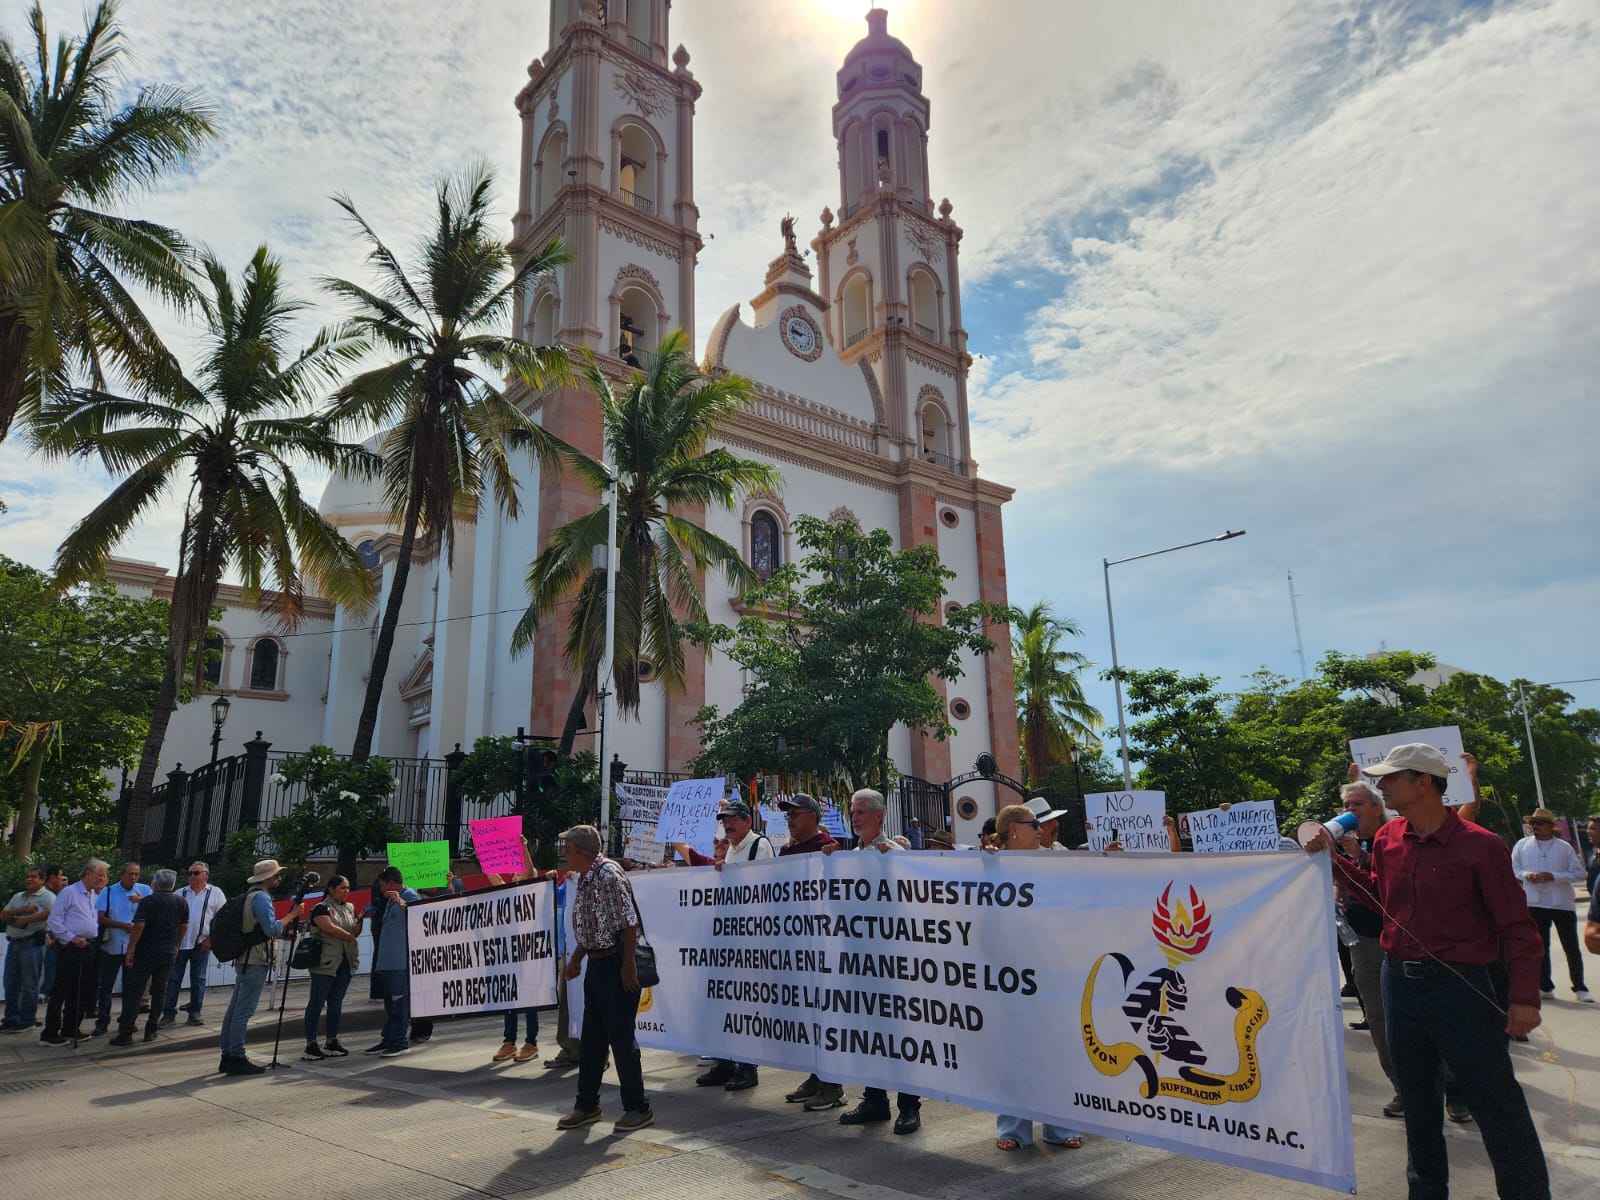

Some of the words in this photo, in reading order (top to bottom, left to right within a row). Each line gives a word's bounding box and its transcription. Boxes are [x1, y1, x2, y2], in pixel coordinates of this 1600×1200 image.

[674, 784, 712, 801] FUERA
[1106, 793, 1134, 814] NO
[665, 826, 698, 841] UAS
[1095, 814, 1153, 832] FOBAPROA
[1193, 813, 1218, 832] ALTO
[1228, 808, 1275, 825] AUMENTO
[1196, 834, 1203, 845] A
[1205, 831, 1224, 843] LAS
[1226, 824, 1276, 837] CUOTAS
[691, 881, 790, 907] DEMANDAMOS
[793, 878, 871, 902] RESPETO
[877, 879, 892, 902] A
[897, 879, 1035, 908] NUESTROS
[422, 909, 439, 937] SIN
[440, 900, 493, 935] AUDITORIA
[496, 897, 511, 926] NO
[513, 893, 536, 922] HAY
[712, 915, 781, 937] DERECHOS
[783, 914, 952, 945] CONTRACTUALES
[956, 920, 972, 946] Y
[410, 941, 473, 976] REINGENIERIA
[473, 940, 480, 967] Y
[482, 936, 509, 966] ESTA
[510, 929, 553, 963] EMPIEZA
[678, 947, 793, 972] TRANSPARENCIA
[795, 949, 816, 972] EN
[838, 951, 939, 984] MANEJO
[943, 961, 978, 990] DE
[983, 964, 1038, 996] LOS
[442, 979, 463, 1008] POR
[707, 979, 779, 1005] RECURSOS
[781, 983, 800, 1008] DE
[638, 1021, 652, 1031] UAS
[652, 1022, 667, 1033] A.C.
[723, 1011, 810, 1046] AUTÓNOMA
[824, 1026, 938, 1066] SINALOA
[1083, 1023, 1118, 1066] UNION
[1229, 1044, 1258, 1092] LIBERACION
[1244, 1005, 1264, 1041] SOCIAL
[1160, 1082, 1222, 1101] SUPERACION
[1073, 1091, 1167, 1121] JUBILADOS
[1170, 1108, 1194, 1127] DE
[1196, 1112, 1220, 1133] LA
[1224, 1118, 1260, 1141] UAS
[1266, 1126, 1305, 1150] A.C.
